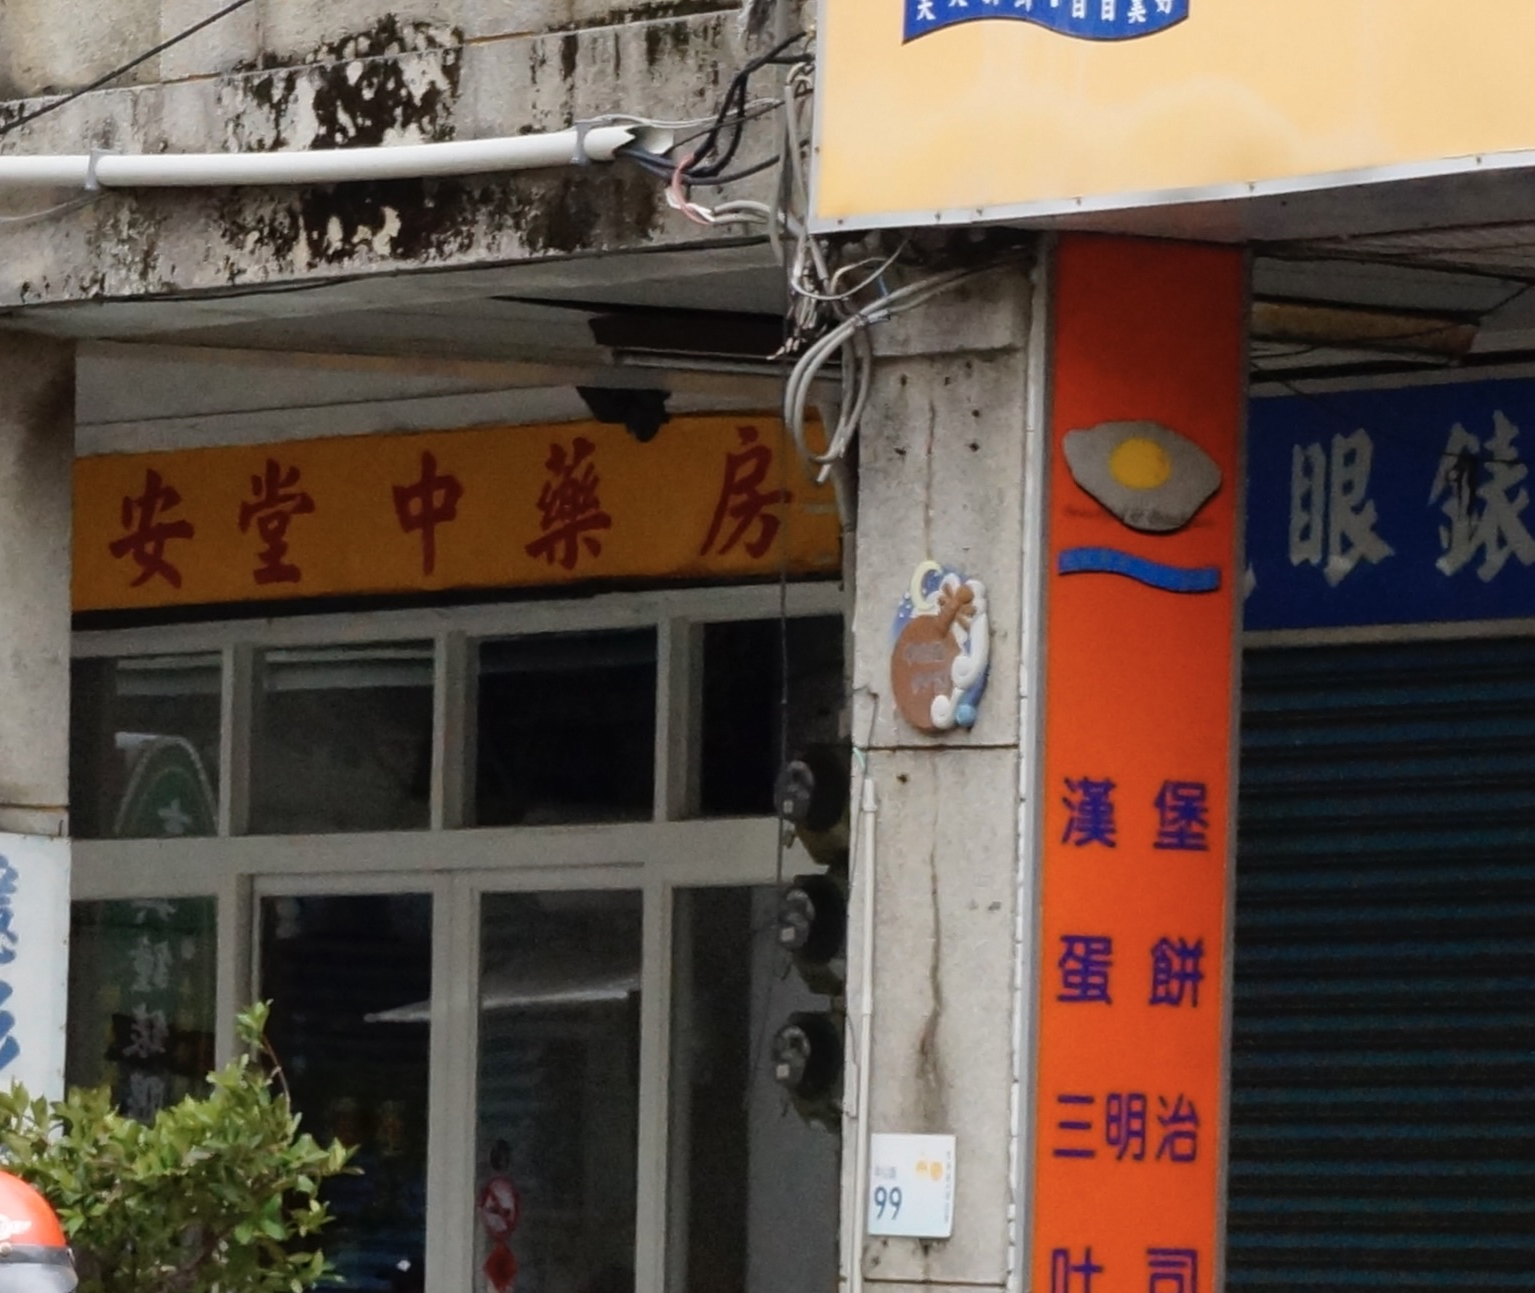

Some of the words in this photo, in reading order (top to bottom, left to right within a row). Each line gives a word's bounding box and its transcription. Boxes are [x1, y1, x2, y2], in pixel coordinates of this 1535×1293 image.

[1061, 776, 1211, 853] 漢堡
[1056, 934, 1205, 1008] 蛋餅
[1052, 1092, 1201, 1163] 三明治
[873, 1185, 903, 1222] 99
